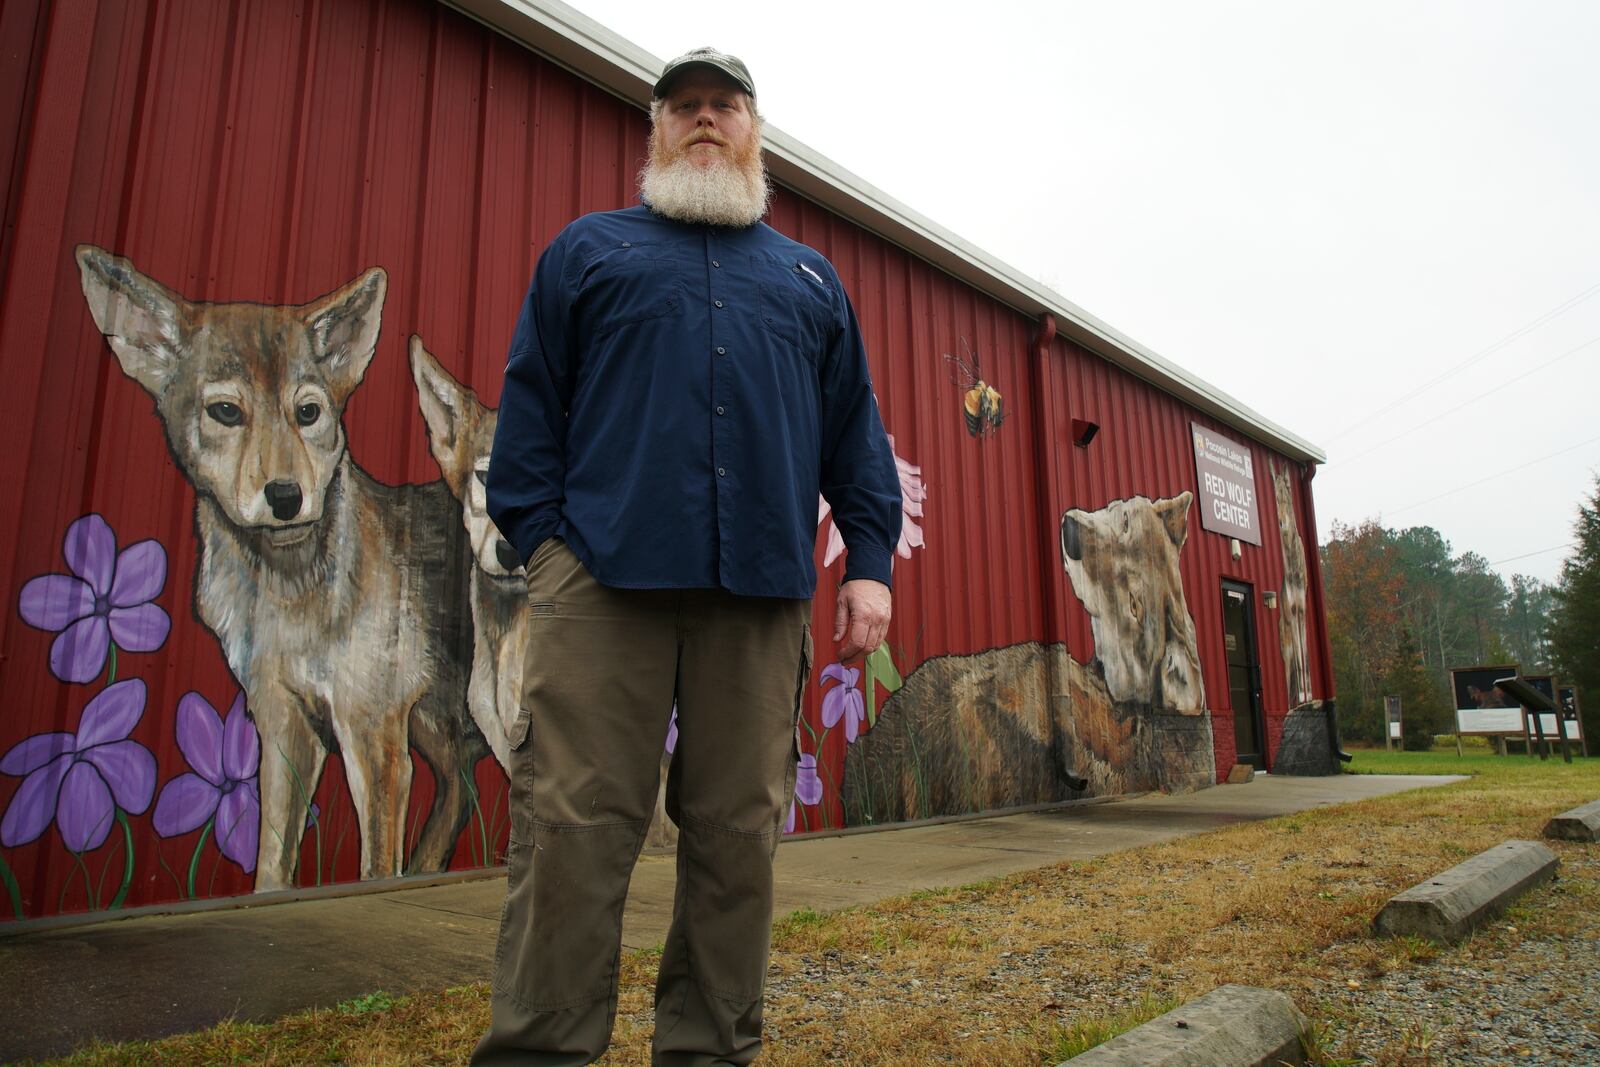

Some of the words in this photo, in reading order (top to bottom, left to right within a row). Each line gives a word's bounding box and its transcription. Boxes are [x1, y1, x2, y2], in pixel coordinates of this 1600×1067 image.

[1227, 447, 1242, 463] Lakes
[1205, 472, 1225, 497] RED
[1226, 481, 1251, 507] WOLF
[1213, 499, 1250, 528] CENTER
